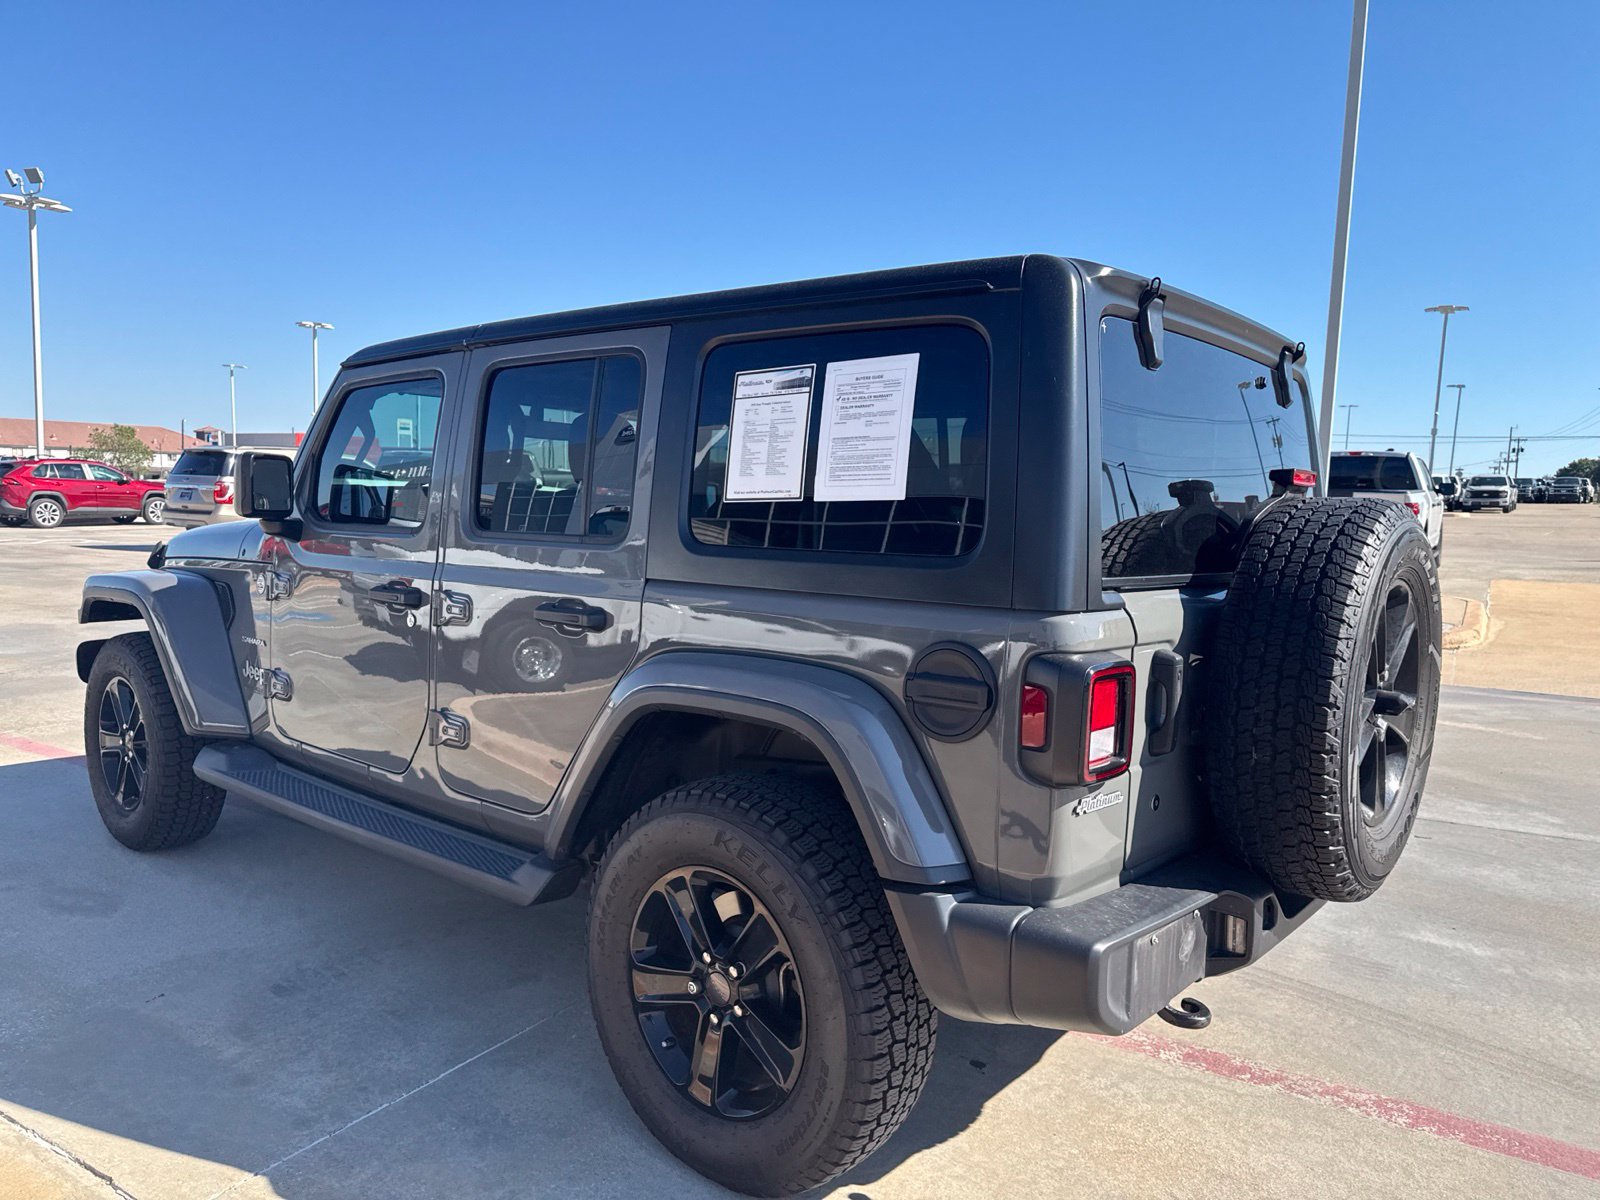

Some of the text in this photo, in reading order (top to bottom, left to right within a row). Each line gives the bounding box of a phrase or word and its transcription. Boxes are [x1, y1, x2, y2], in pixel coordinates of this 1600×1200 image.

[242, 660, 264, 685] Jeep
[1077, 792, 1123, 816] Platinum
[713, 831, 809, 923] KELLY
